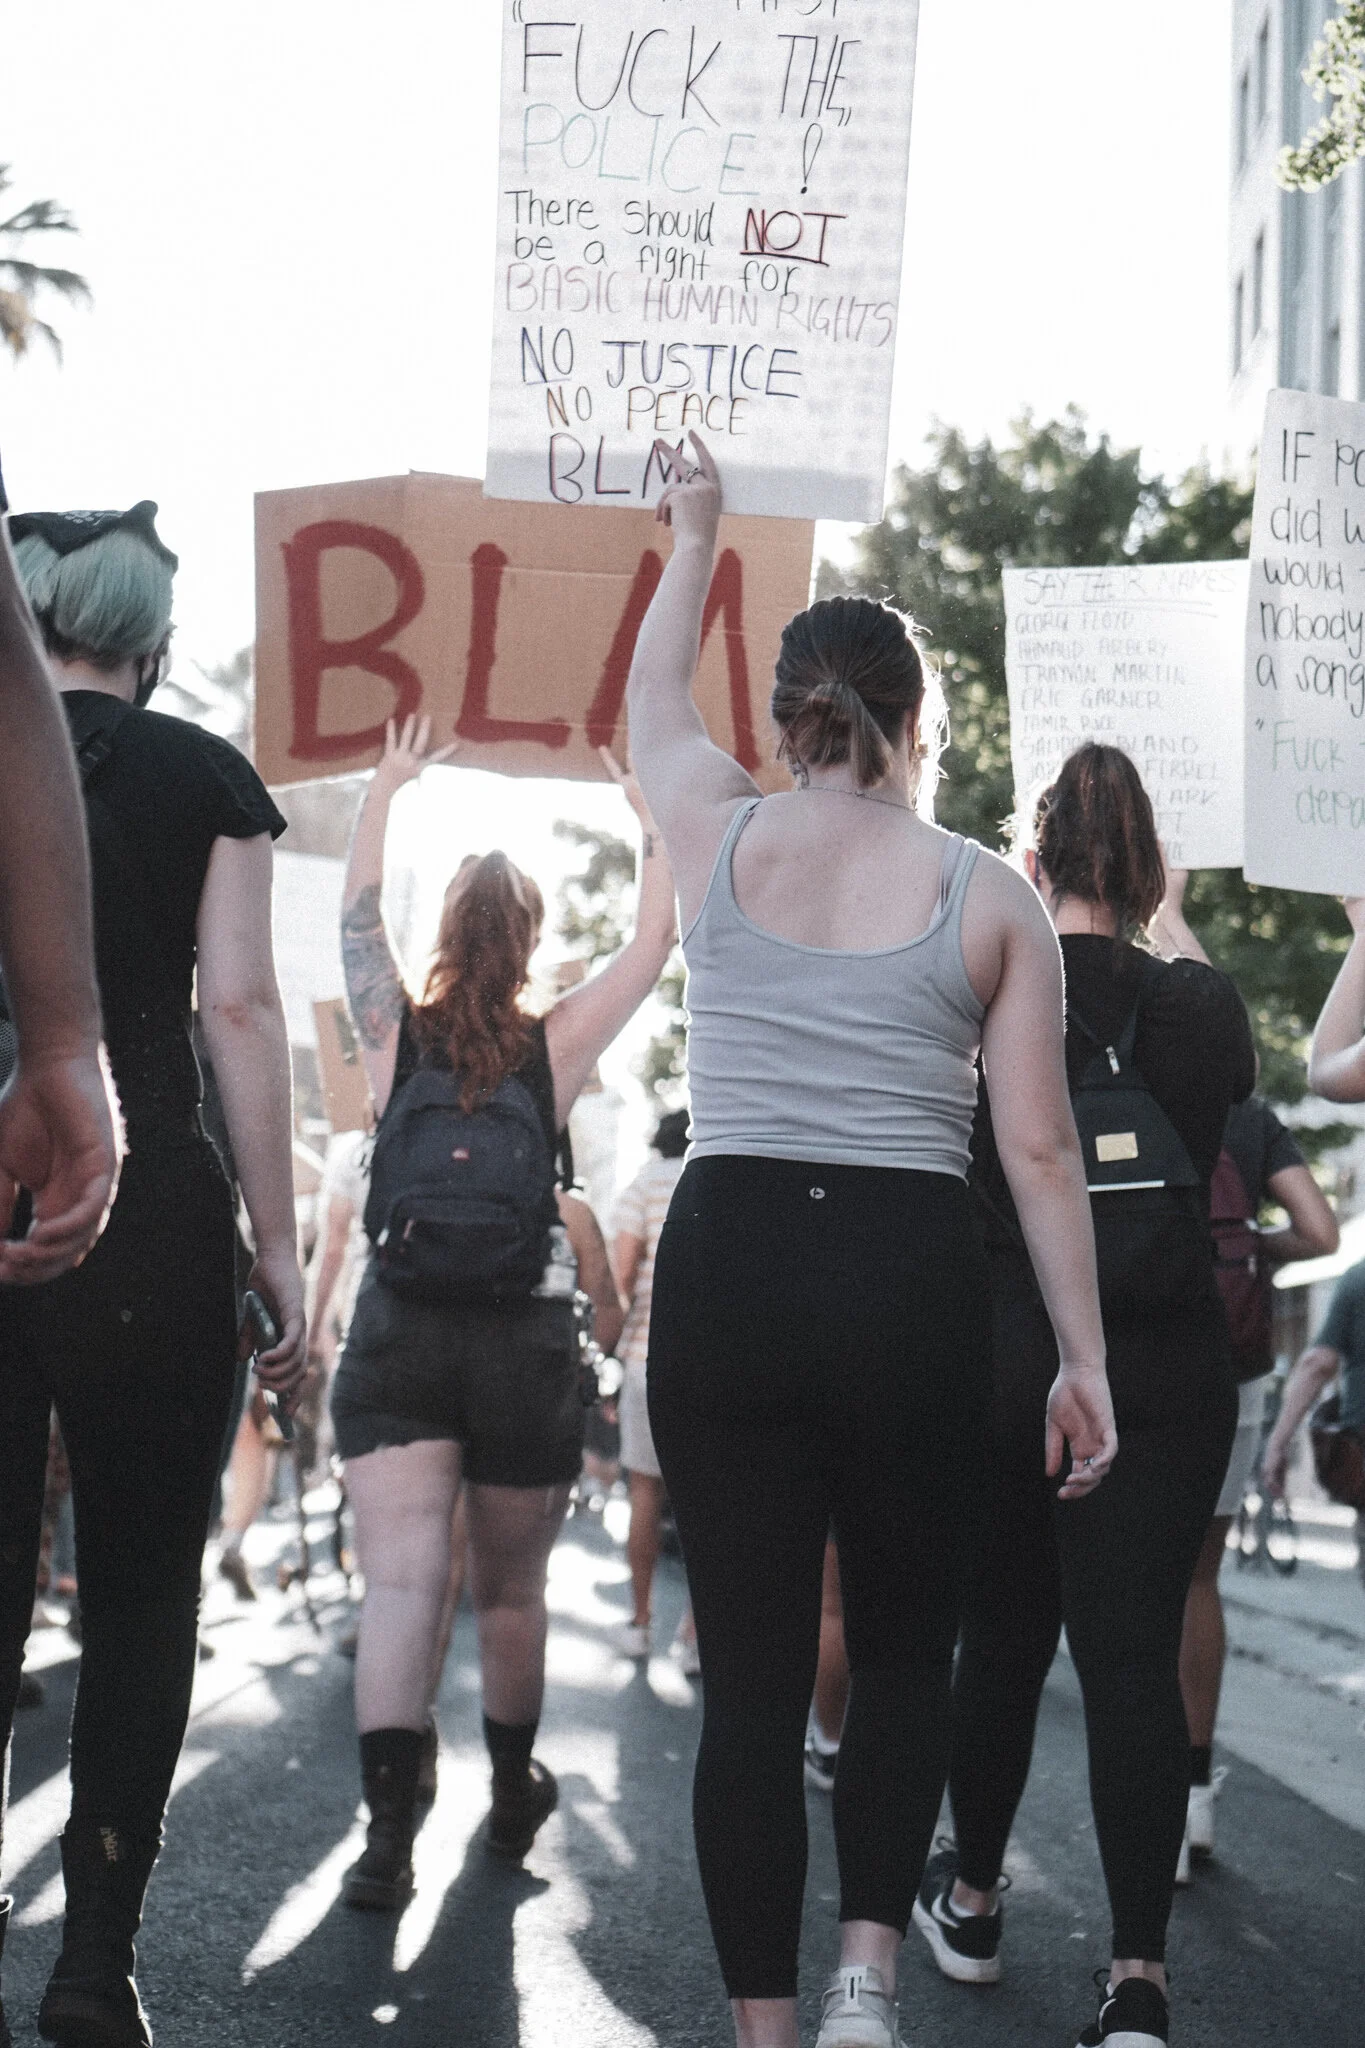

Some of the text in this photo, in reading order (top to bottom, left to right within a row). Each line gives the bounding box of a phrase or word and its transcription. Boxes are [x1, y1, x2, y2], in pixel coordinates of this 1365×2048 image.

[524, 103, 760, 195] POLICE
[504, 189, 600, 230] There
[742, 207, 848, 264] NOT
[514, 228, 800, 297] be a fight for
[506, 262, 898, 347] BASIC HUMAN RIGHTS
[520, 325, 802, 399] NO JUSTICE
[546, 385, 750, 435] NO PEACE
[549, 432, 685, 504] BLM
[1282, 428, 1316, 484] IF
[1270, 497, 1323, 549] did
[1023, 570, 1070, 605] SAY
[1263, 557, 1345, 594] would
[281, 519, 762, 774] BLM
[1260, 601, 1364, 660] nobody
[1079, 687, 1163, 711] GARNER
[1256, 654, 1365, 719] a song
